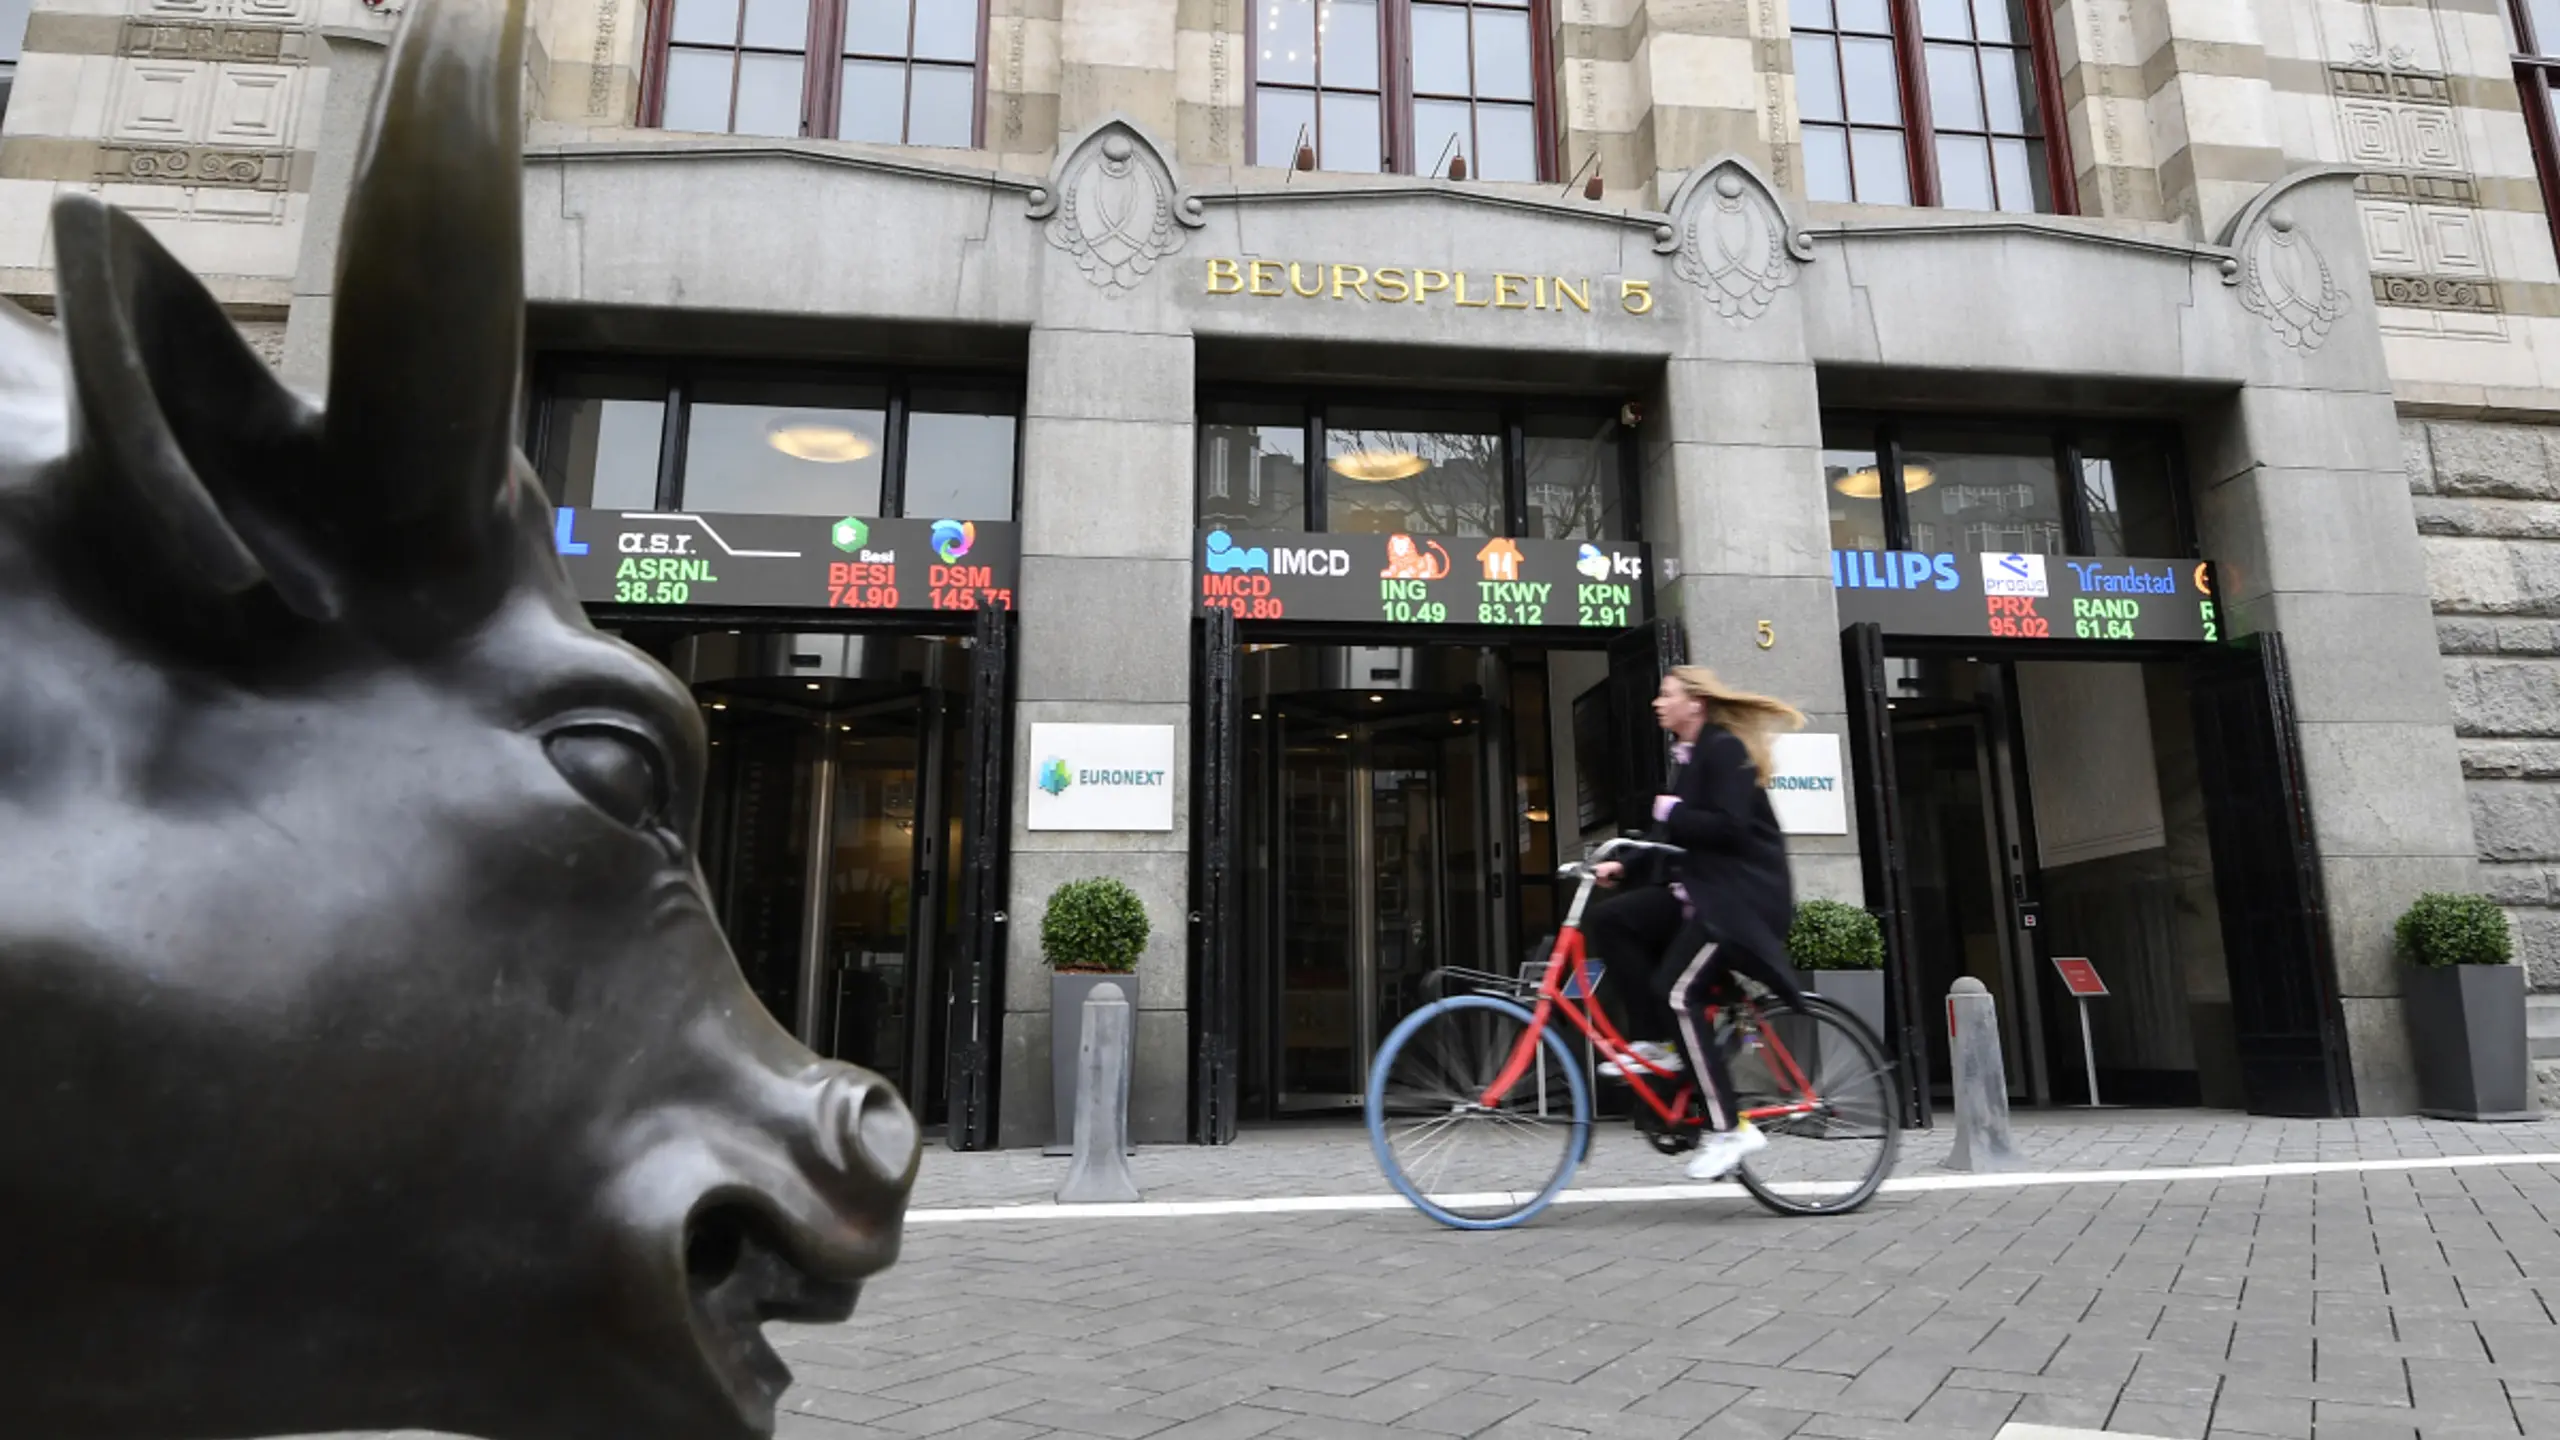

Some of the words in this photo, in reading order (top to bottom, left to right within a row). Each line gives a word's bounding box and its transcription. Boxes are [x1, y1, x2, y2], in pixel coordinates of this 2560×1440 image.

[1205, 257, 1592, 313] BEURSPLEIN
[1620, 279, 1655, 315] 5
[859, 549, 896, 564] Besi
[1272, 547, 1351, 577] IMCD
[615, 557, 718, 582] ASRNL
[828, 562, 896, 586] BESI
[928, 564, 992, 588] DSM
[2093, 565, 2176, 595] randstad
[614, 580, 690, 604] 38.50
[827, 585, 899, 609] 74.90
[1202, 574, 1272, 597] IMCD
[1380, 578, 1428, 601] ING
[1476, 580, 1553, 604] TKWY
[1577, 582, 1632, 606] KPN
[1381, 600, 1447, 624] 10.49
[1477, 603, 1543, 626] 83.12
[1578, 604, 1628, 628] 2.91
[1986, 596, 2039, 618] PRX
[2071, 598, 2140, 620] RAND
[1757, 620, 1775, 650] 5
[1988, 617, 2051, 639] 95.02
[2074, 619, 2136, 640] 61.64
[1079, 768, 1166, 787] EURONEXT
